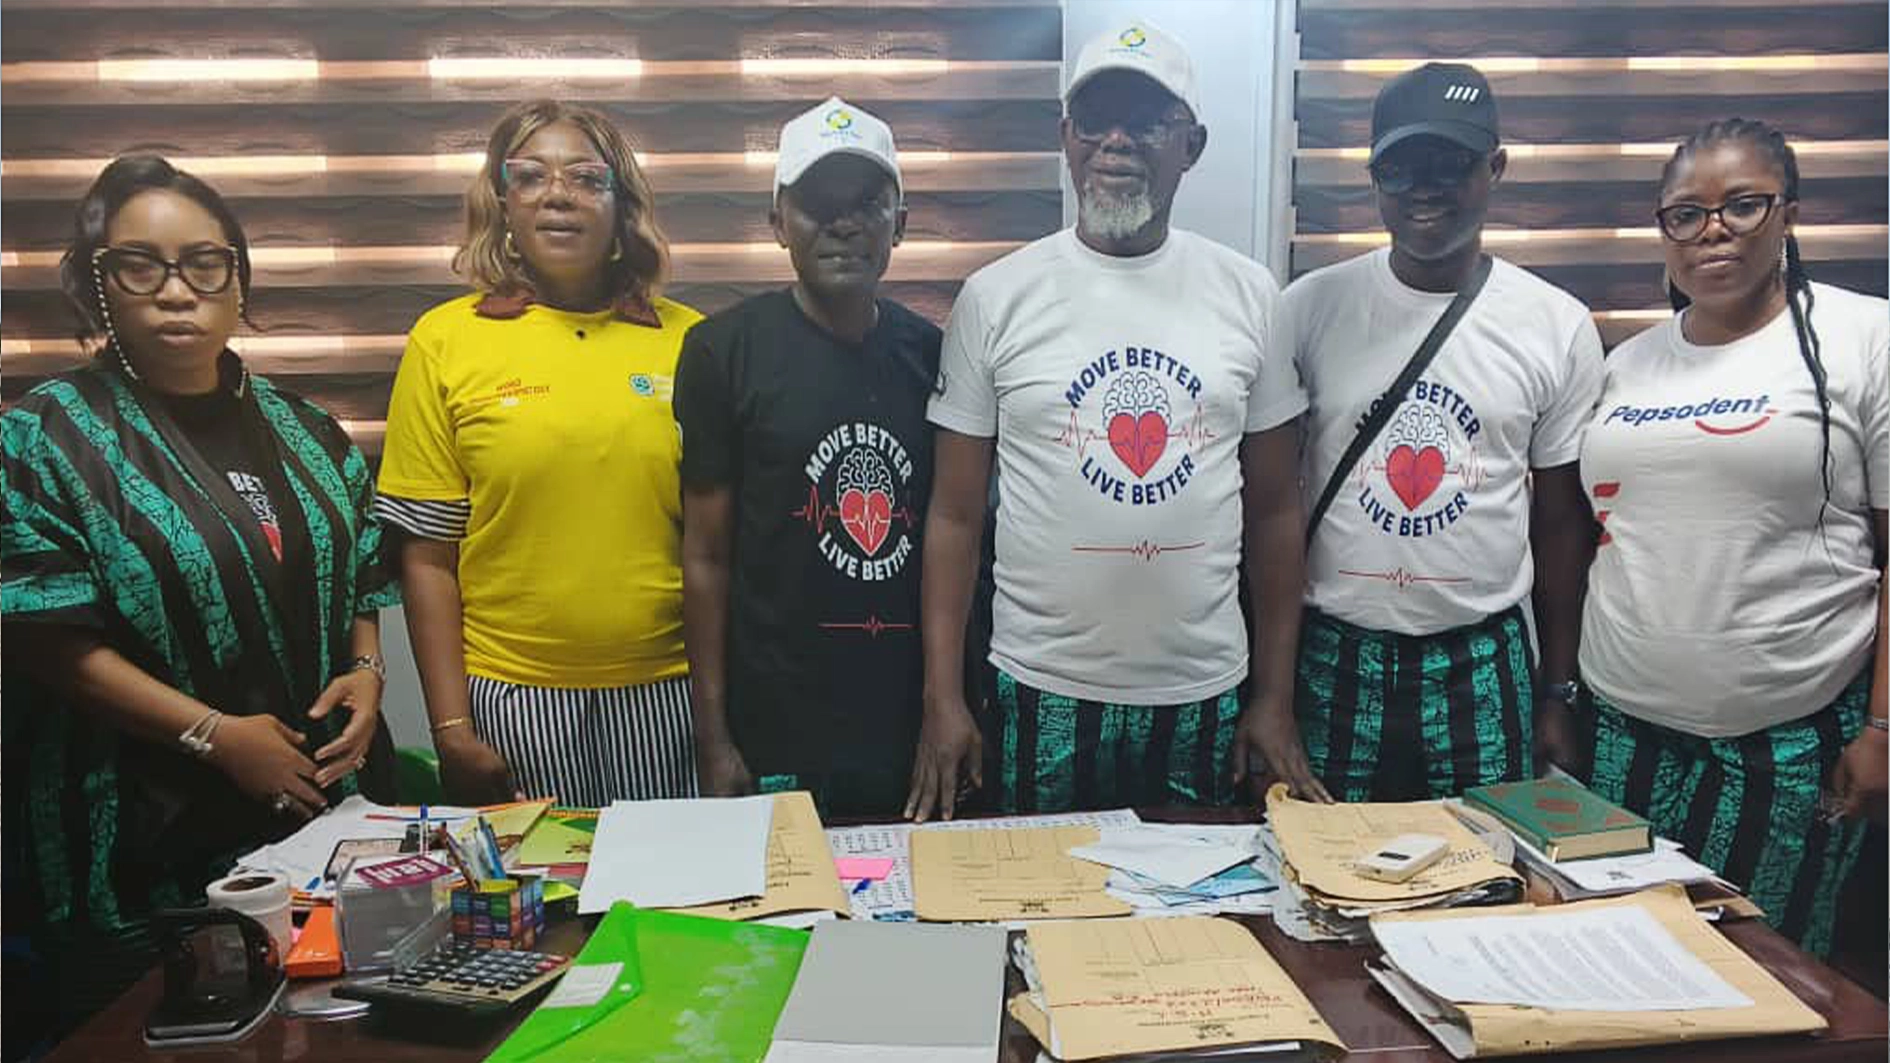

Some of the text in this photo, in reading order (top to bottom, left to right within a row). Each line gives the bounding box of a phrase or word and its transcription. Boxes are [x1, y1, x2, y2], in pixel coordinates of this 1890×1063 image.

[1065, 346, 1202, 409] MOVE BETTER
[1416, 380, 1481, 440] BETTER
[1604, 395, 1771, 426] Pepsodent
[805, 422, 913, 485] MOVE BETTER
[1081, 454, 1195, 505] LIVE BETTER
[1358, 487, 1469, 537] LIVE BETTER
[818, 531, 913, 581] LIVE BETTER
